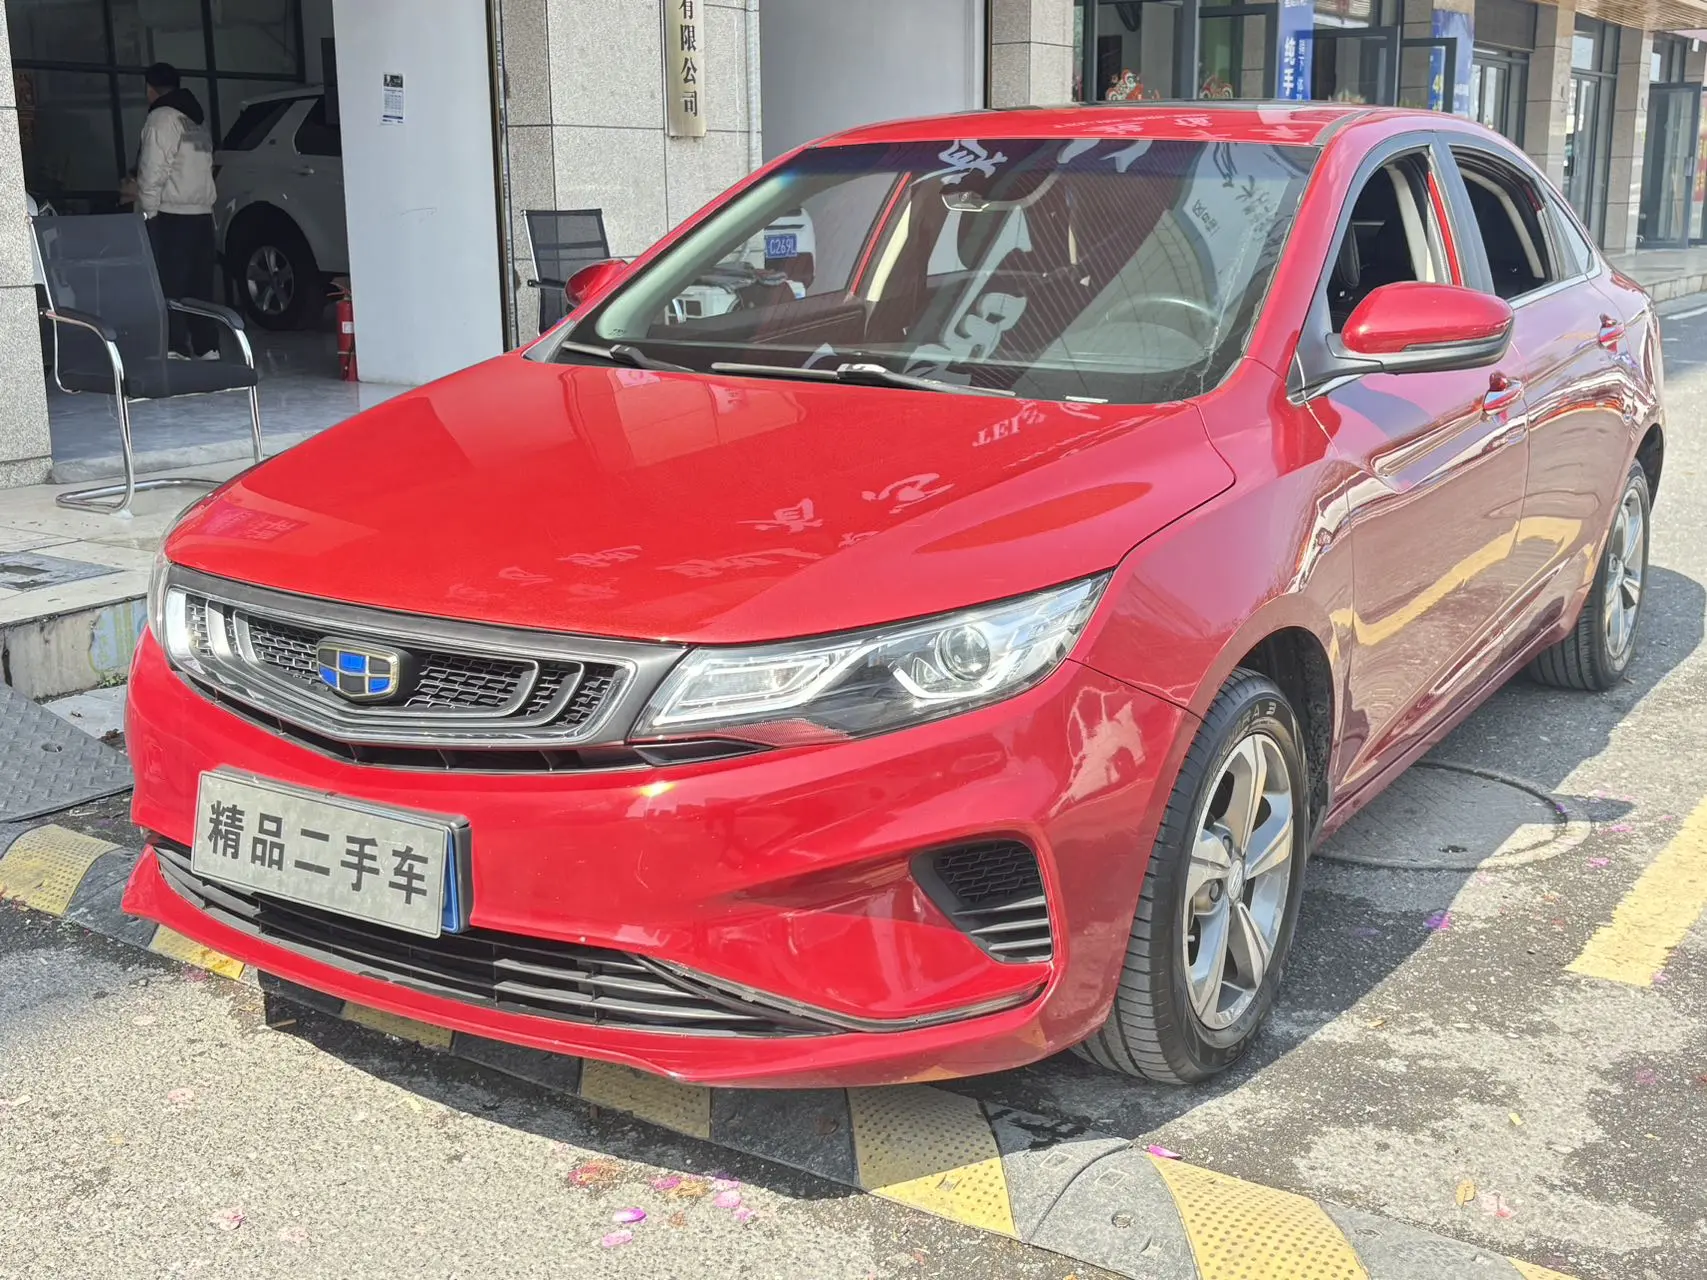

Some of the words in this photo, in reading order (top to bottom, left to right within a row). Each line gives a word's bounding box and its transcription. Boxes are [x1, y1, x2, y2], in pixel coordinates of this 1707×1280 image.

[679, 0, 697, 117] 有限公司
[207, 800, 428, 905] 精品二手车
